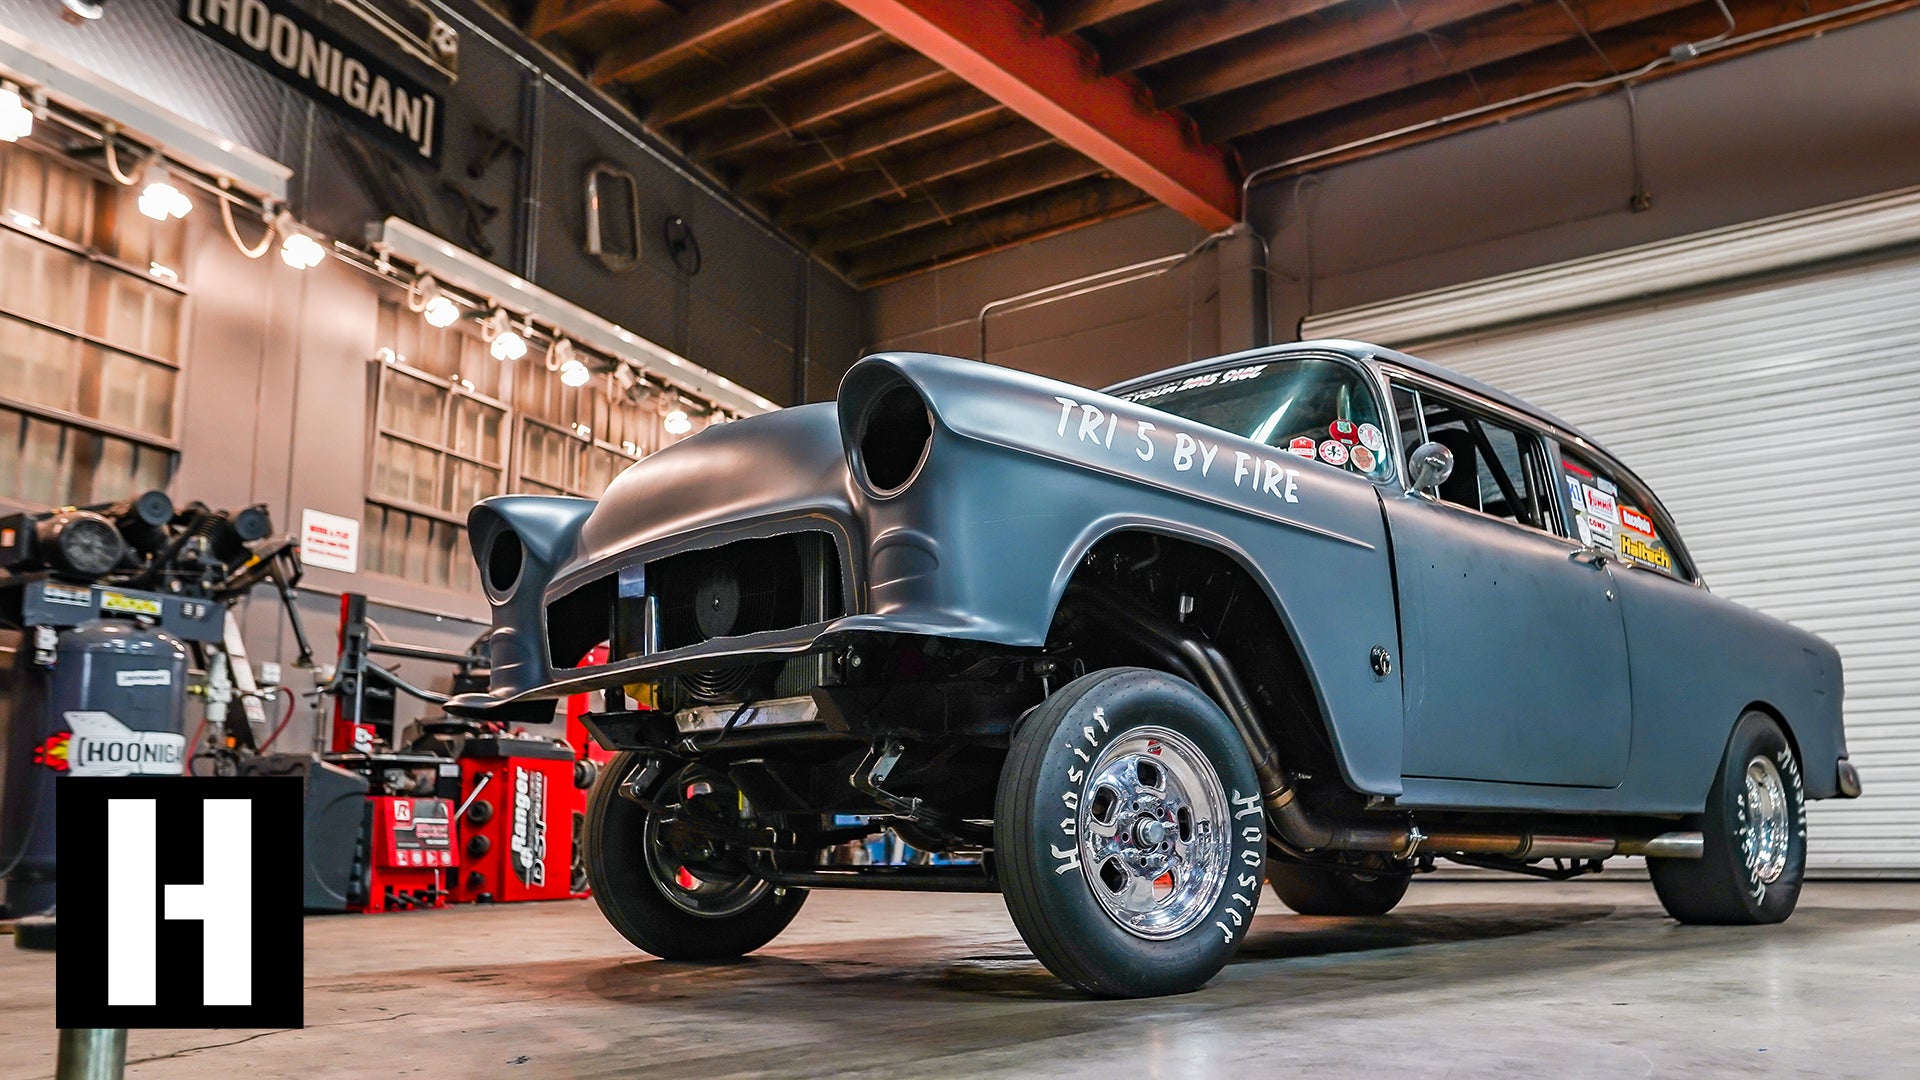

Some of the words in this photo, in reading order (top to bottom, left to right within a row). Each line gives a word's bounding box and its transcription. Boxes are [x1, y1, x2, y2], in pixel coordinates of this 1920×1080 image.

[1054, 396, 1118, 450] TRI
[1135, 420, 1157, 462] 5
[1173, 432, 1219, 478] BY
[1233, 450, 1301, 504] FIRE
[1621, 534, 1671, 570] Haltech
[511, 766, 531, 852] Ranger
[1050, 706, 1110, 875] Hoosier
[1216, 789, 1265, 944] Hoosier
